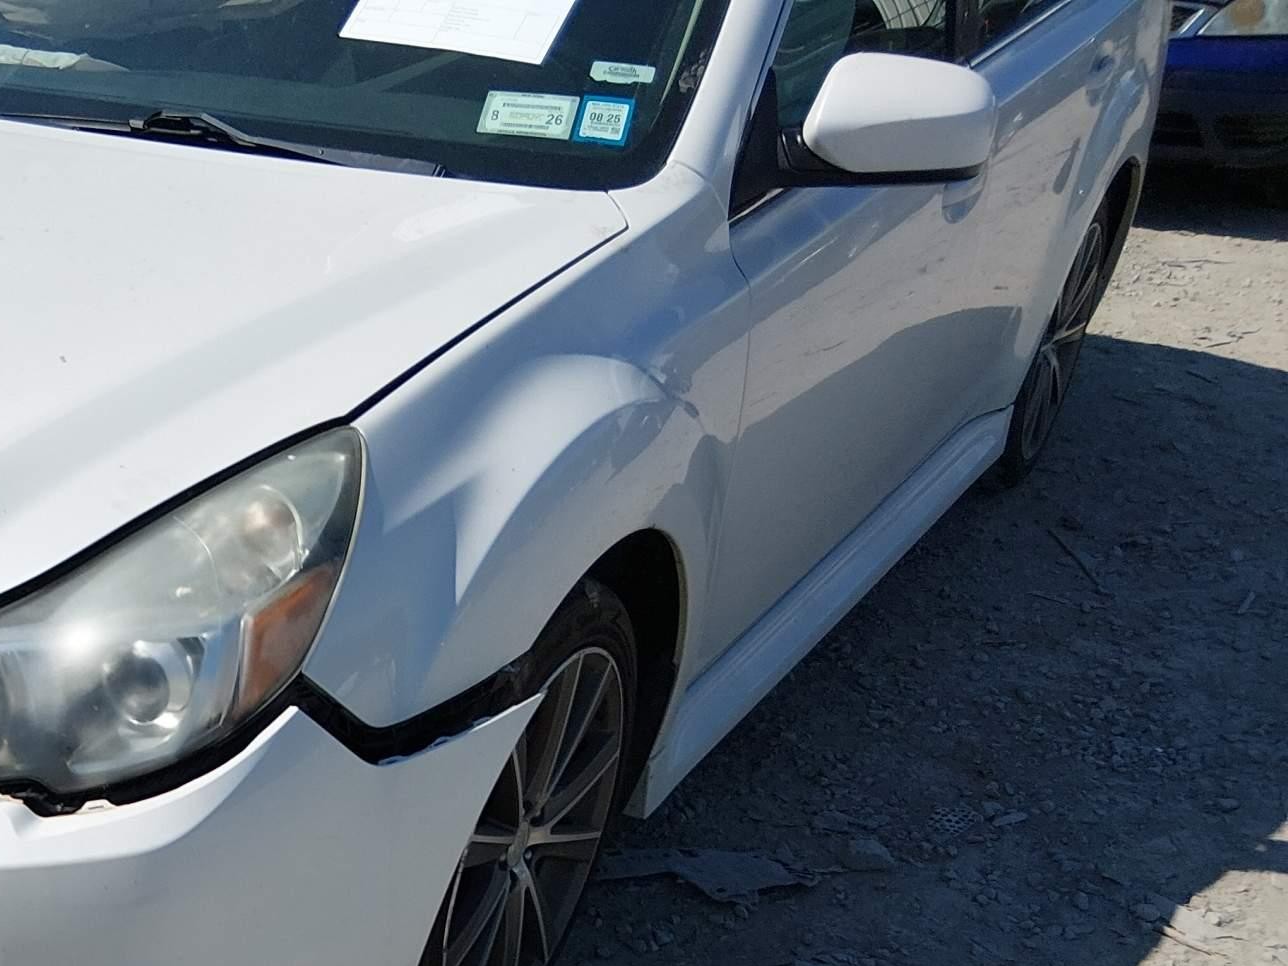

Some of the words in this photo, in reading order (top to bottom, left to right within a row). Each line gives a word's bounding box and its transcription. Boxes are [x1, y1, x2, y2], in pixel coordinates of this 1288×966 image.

[491, 110, 499, 121] 8
[545, 113, 564, 126] 26
[606, 113, 622, 123] 25
